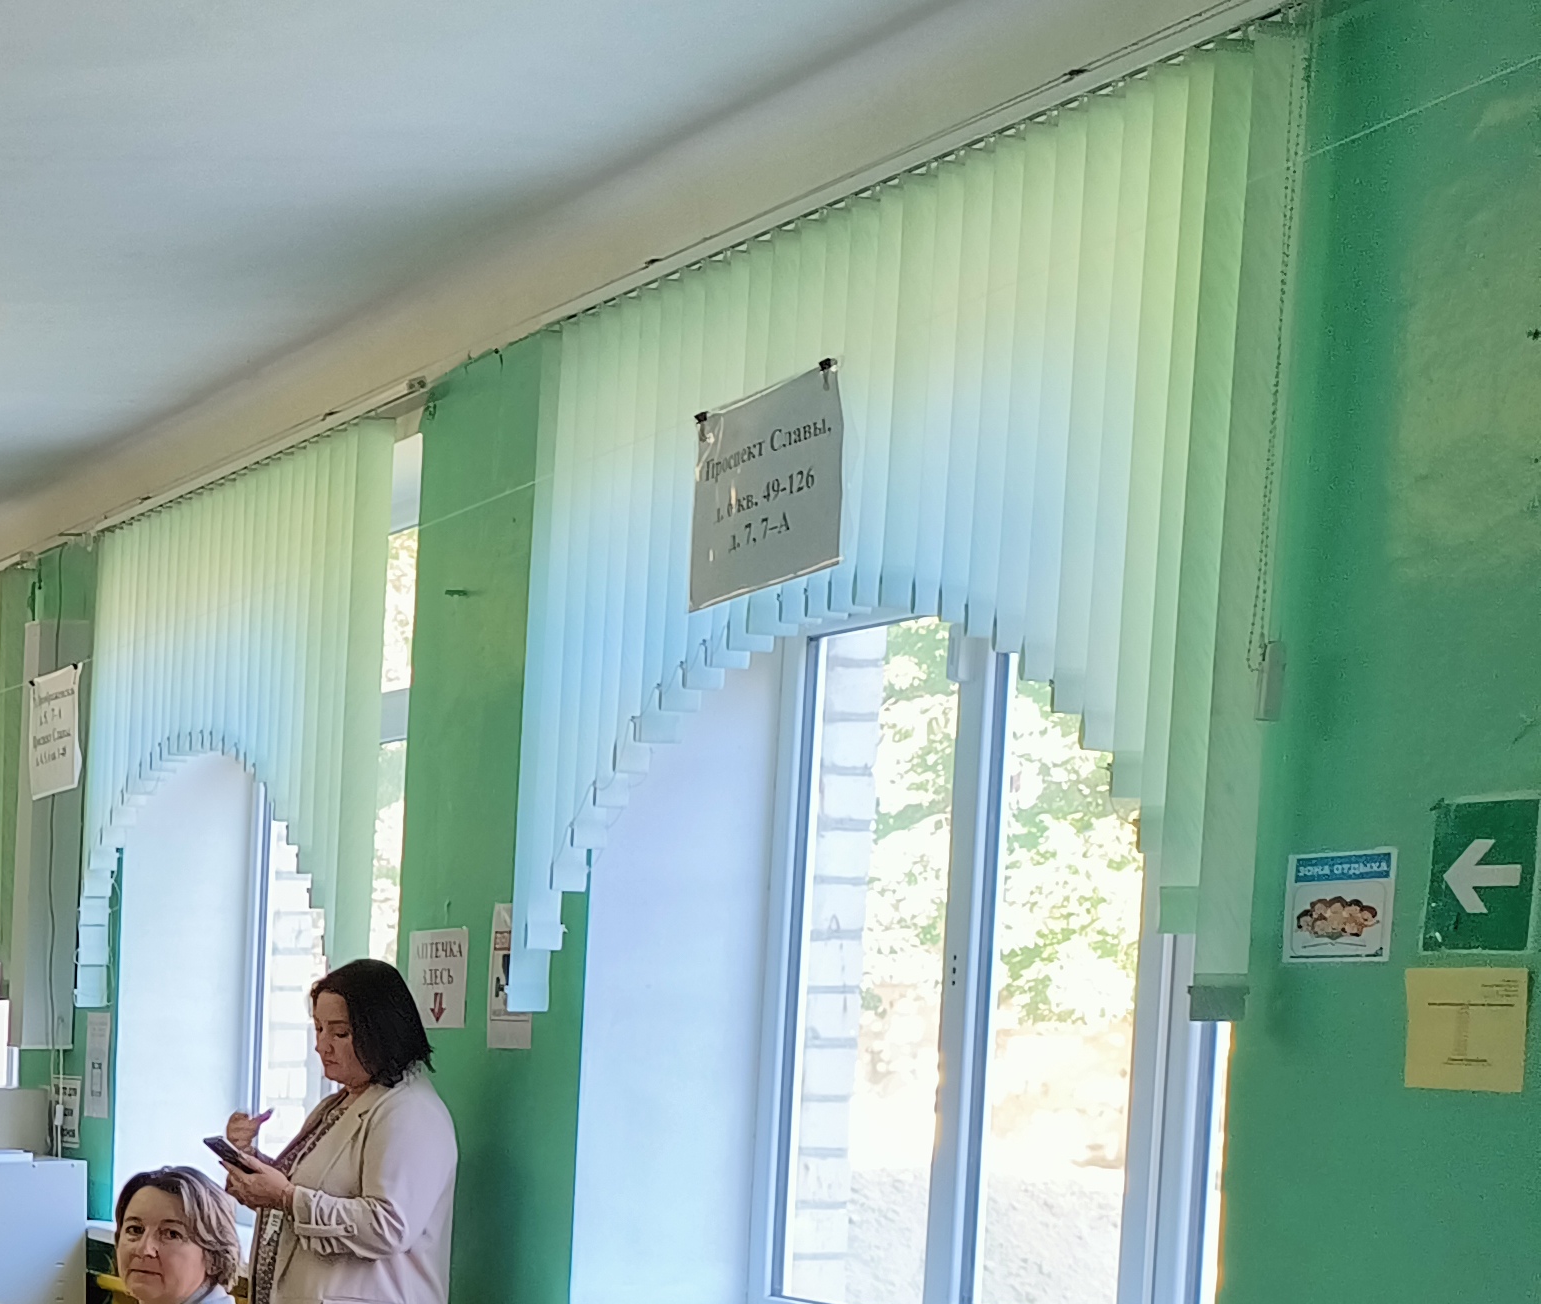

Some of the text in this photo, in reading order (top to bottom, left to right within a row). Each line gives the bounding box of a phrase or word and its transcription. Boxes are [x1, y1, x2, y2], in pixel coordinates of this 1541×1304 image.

[705, 418, 832, 483] Проспект Славы,
[737, 494, 758, 513] кв.
[763, 465, 815, 502] 49-126
[1298, 862, 1388, 877] ЗОНА ОТДЫХА
[416, 941, 463, 960] АПТЕЧКА
[422, 968, 454, 986] ЗДЕСЬ
